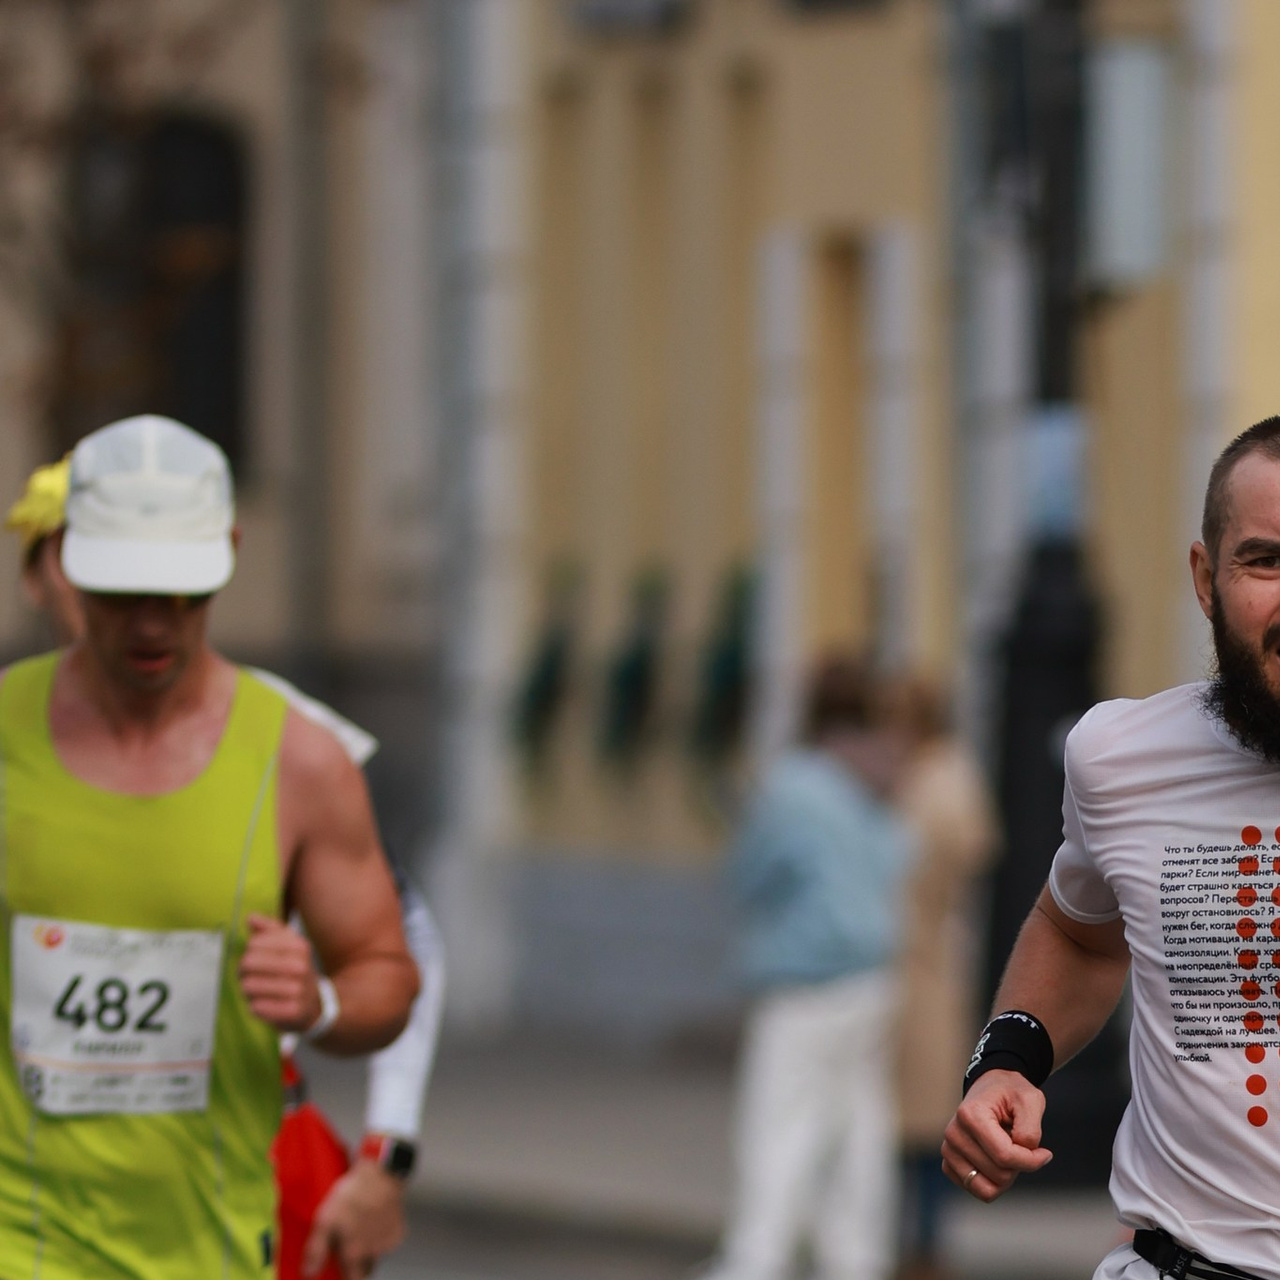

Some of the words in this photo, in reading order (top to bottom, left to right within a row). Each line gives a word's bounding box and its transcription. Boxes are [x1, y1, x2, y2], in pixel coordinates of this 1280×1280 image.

[1164, 846, 1181, 854] Что
[1196, 844, 1232, 854] будешь
[1233, 844, 1269, 855] делать,
[1161, 858, 1200, 867] отменят
[1220, 854, 1259, 865] забеги?
[1160, 869, 1193, 880] парки?
[1195, 869, 1219, 878] Если
[1221, 870, 1241, 878] мир
[1243, 869, 1275, 877] станет
[1159, 882, 1185, 893] будет
[1187, 883, 1229, 891] страшно
[1231, 882, 1274, 890] касаться
[1160, 894, 1210, 906] вопросов?
[1211, 894, 1278, 905] Перестанешь
[1161, 909, 1190, 920] вокруг
[1191, 906, 1266, 918] остановилось?
[1267, 906, 1275, 916] Я
[1162, 923, 1189, 933] нужен
[1190, 921, 1208, 931] бег,
[1209, 921, 1236, 931] когда
[1238, 921, 1276, 930] сложно
[1163, 935, 1187, 945] Когда
[1188, 935, 1240, 944] мотивация
[1164, 949, 1232, 958] самоизоляции.
[1233, 947, 1261, 957] Когда
[1176, 961, 1257, 971] неопределённый
[1168, 976, 1229, 984] компенсации.
[1230, 973, 1247, 983] Эта
[1170, 988, 1225, 997] отказываюсь
[1226, 988, 1269, 998] унывать.
[53, 975, 170, 1033] 482
[1185, 1000, 1198, 1010] бы
[1199, 1002, 1211, 1010] ни
[1213, 1001, 1271, 1011] произошло,
[1173, 1015, 1212, 1024] одиночку
[1174, 1026, 1180, 1036] С
[1181, 1027, 1223, 1036] надеждой
[1225, 1028, 1237, 1036] на
[1239, 1028, 1278, 1037] лучшее.
[1175, 1041, 1229, 1051] ограничения
